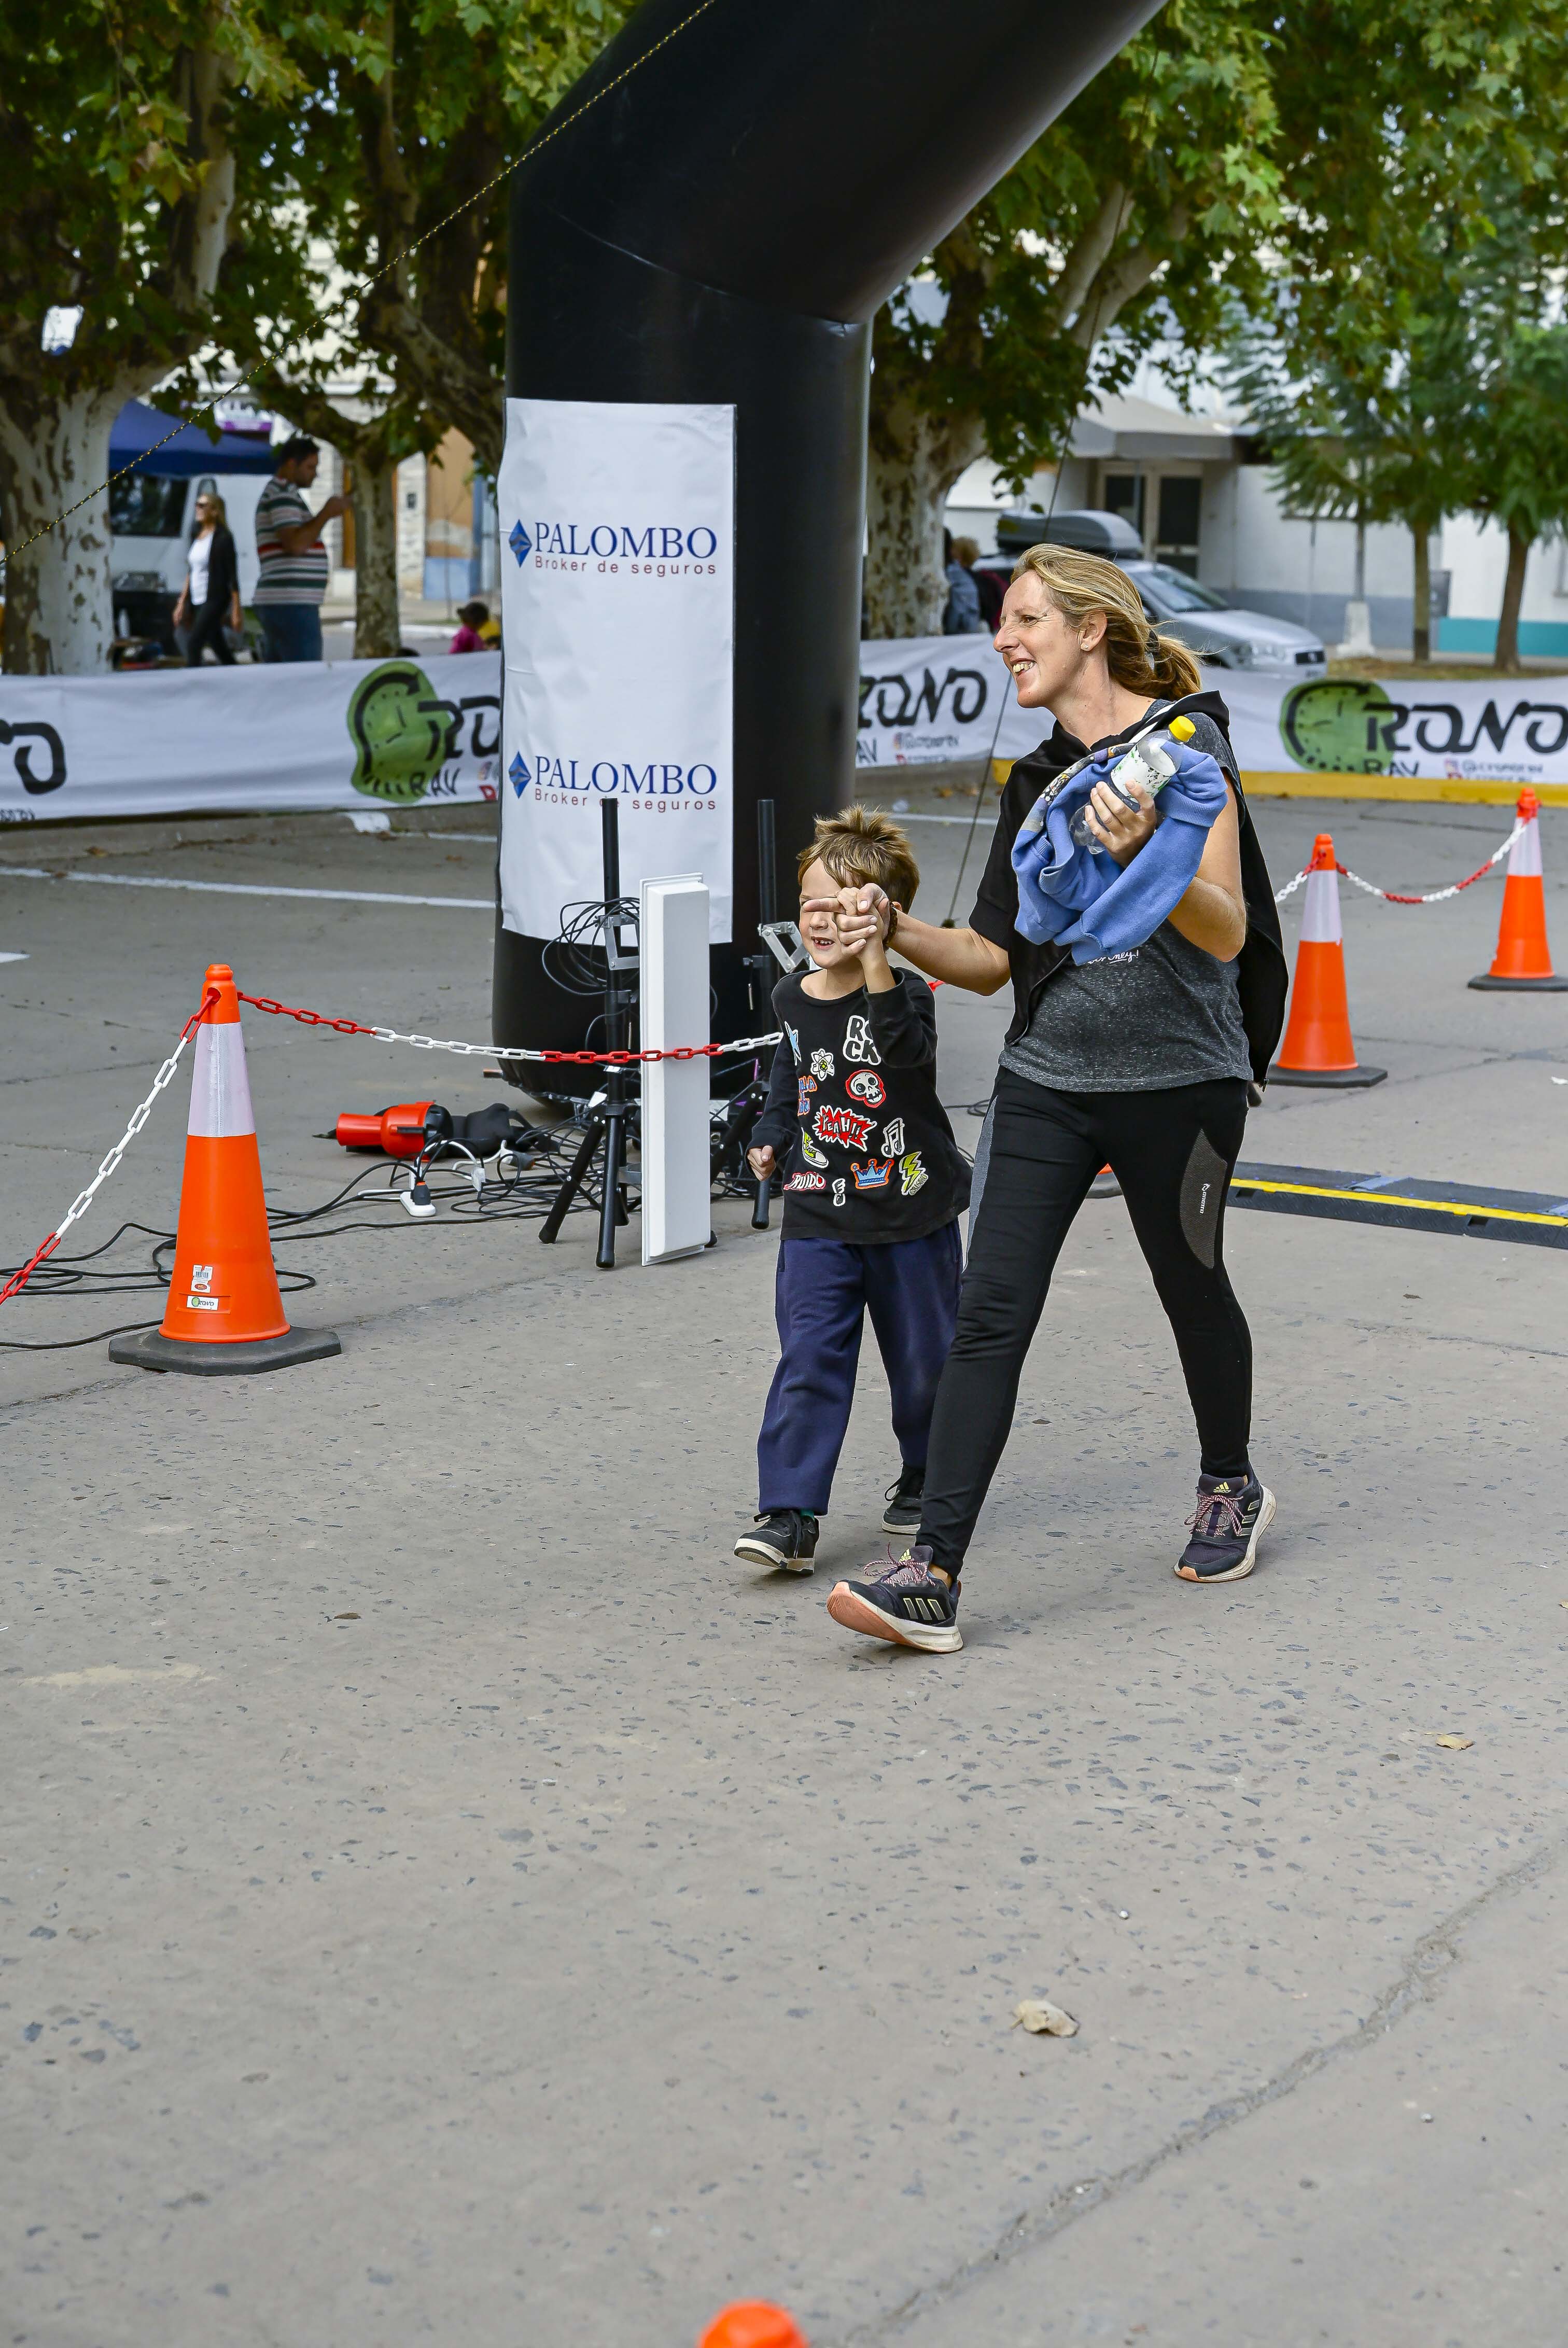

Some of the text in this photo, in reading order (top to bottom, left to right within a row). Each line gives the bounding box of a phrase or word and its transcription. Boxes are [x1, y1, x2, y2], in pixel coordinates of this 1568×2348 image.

[535, 522, 717, 558] PALOMBO
[535, 555, 716, 577] Broker de seguros
[535, 756, 717, 794] PALOMBO
[535, 788, 587, 806] Broker
[633, 800, 716, 813] seguros
